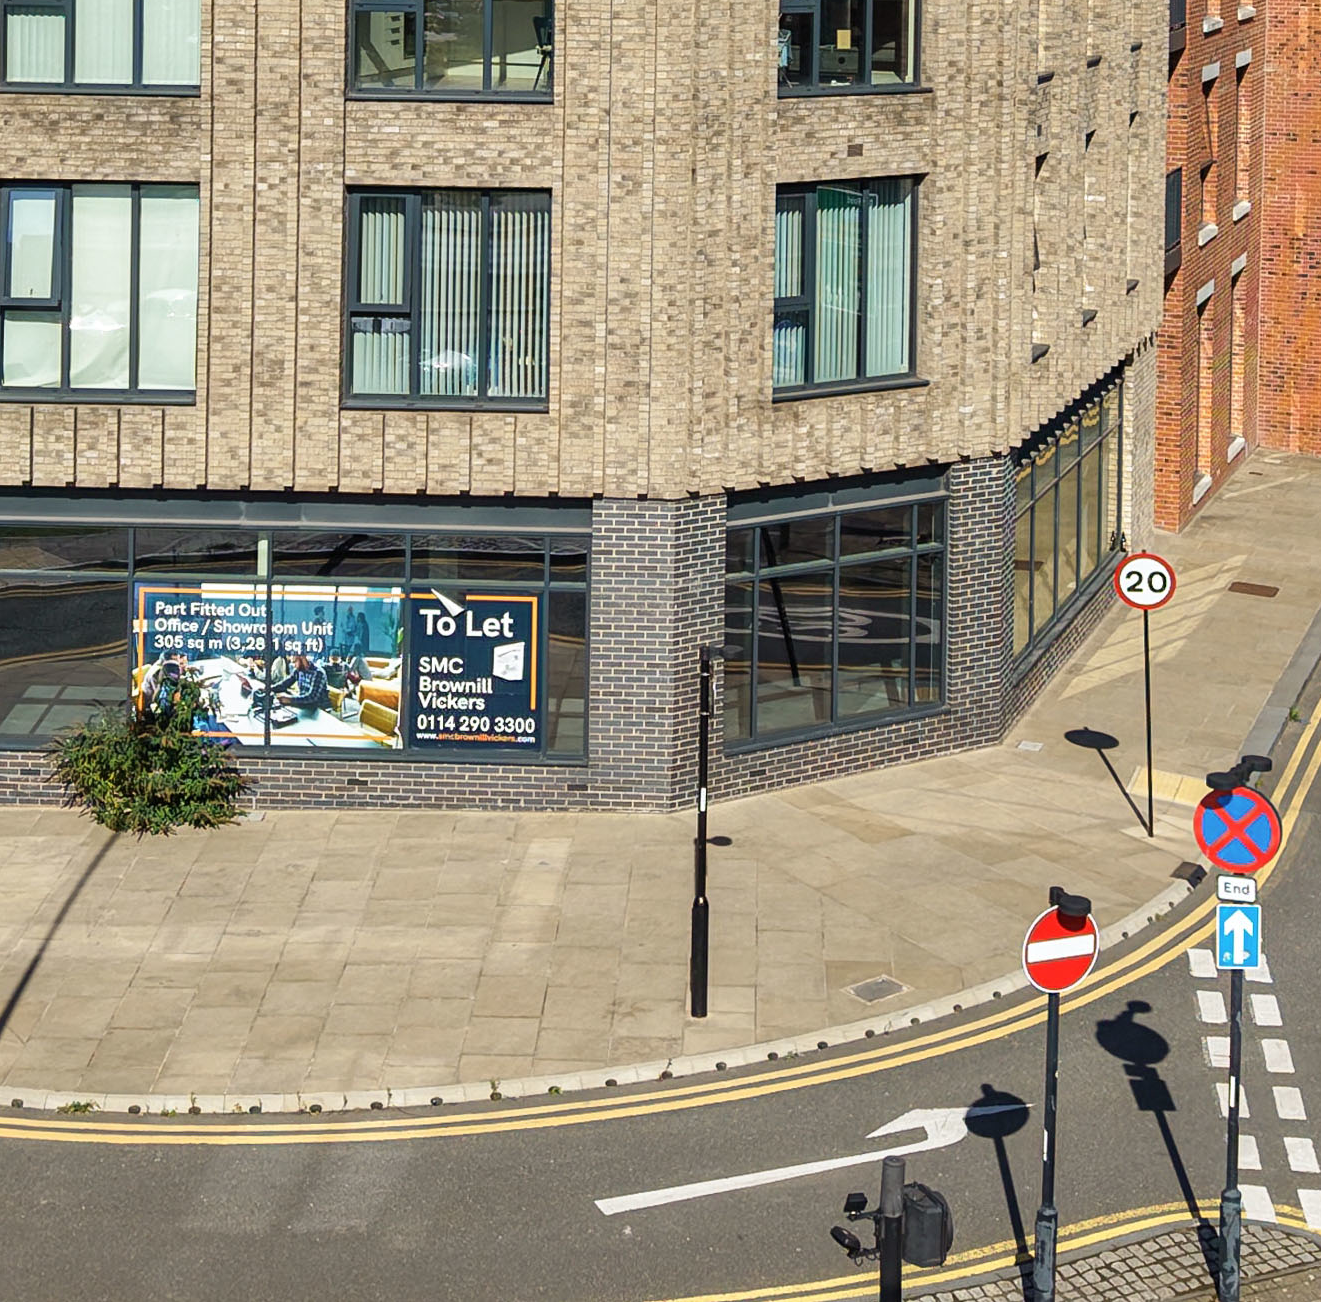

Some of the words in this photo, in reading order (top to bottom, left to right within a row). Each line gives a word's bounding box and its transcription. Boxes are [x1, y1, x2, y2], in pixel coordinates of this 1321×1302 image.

[1125, 570, 1167, 593] 20
[155, 601, 186, 616] Part
[190, 602, 235, 617] Fitted
[238, 603, 267, 617] Out
[154, 618, 199, 633] Office
[301, 621, 334, 636] Unit
[419, 609, 456, 636] To
[466, 610, 514, 638] Let
[154, 635, 183, 649] 305
[187, 638, 204, 653] sq
[208, 639, 222, 650] m
[284, 639, 302, 654] sq
[305, 637, 323, 652] ft)
[419, 656, 464, 674] SMC
[419, 676, 493, 694] Brownill
[418, 692, 485, 710] Vickers
[417, 714, 455, 731] 0114
[459, 716, 490, 732] 290
[494, 717, 535, 734] 3300
[1224, 882, 1250, 895] End
